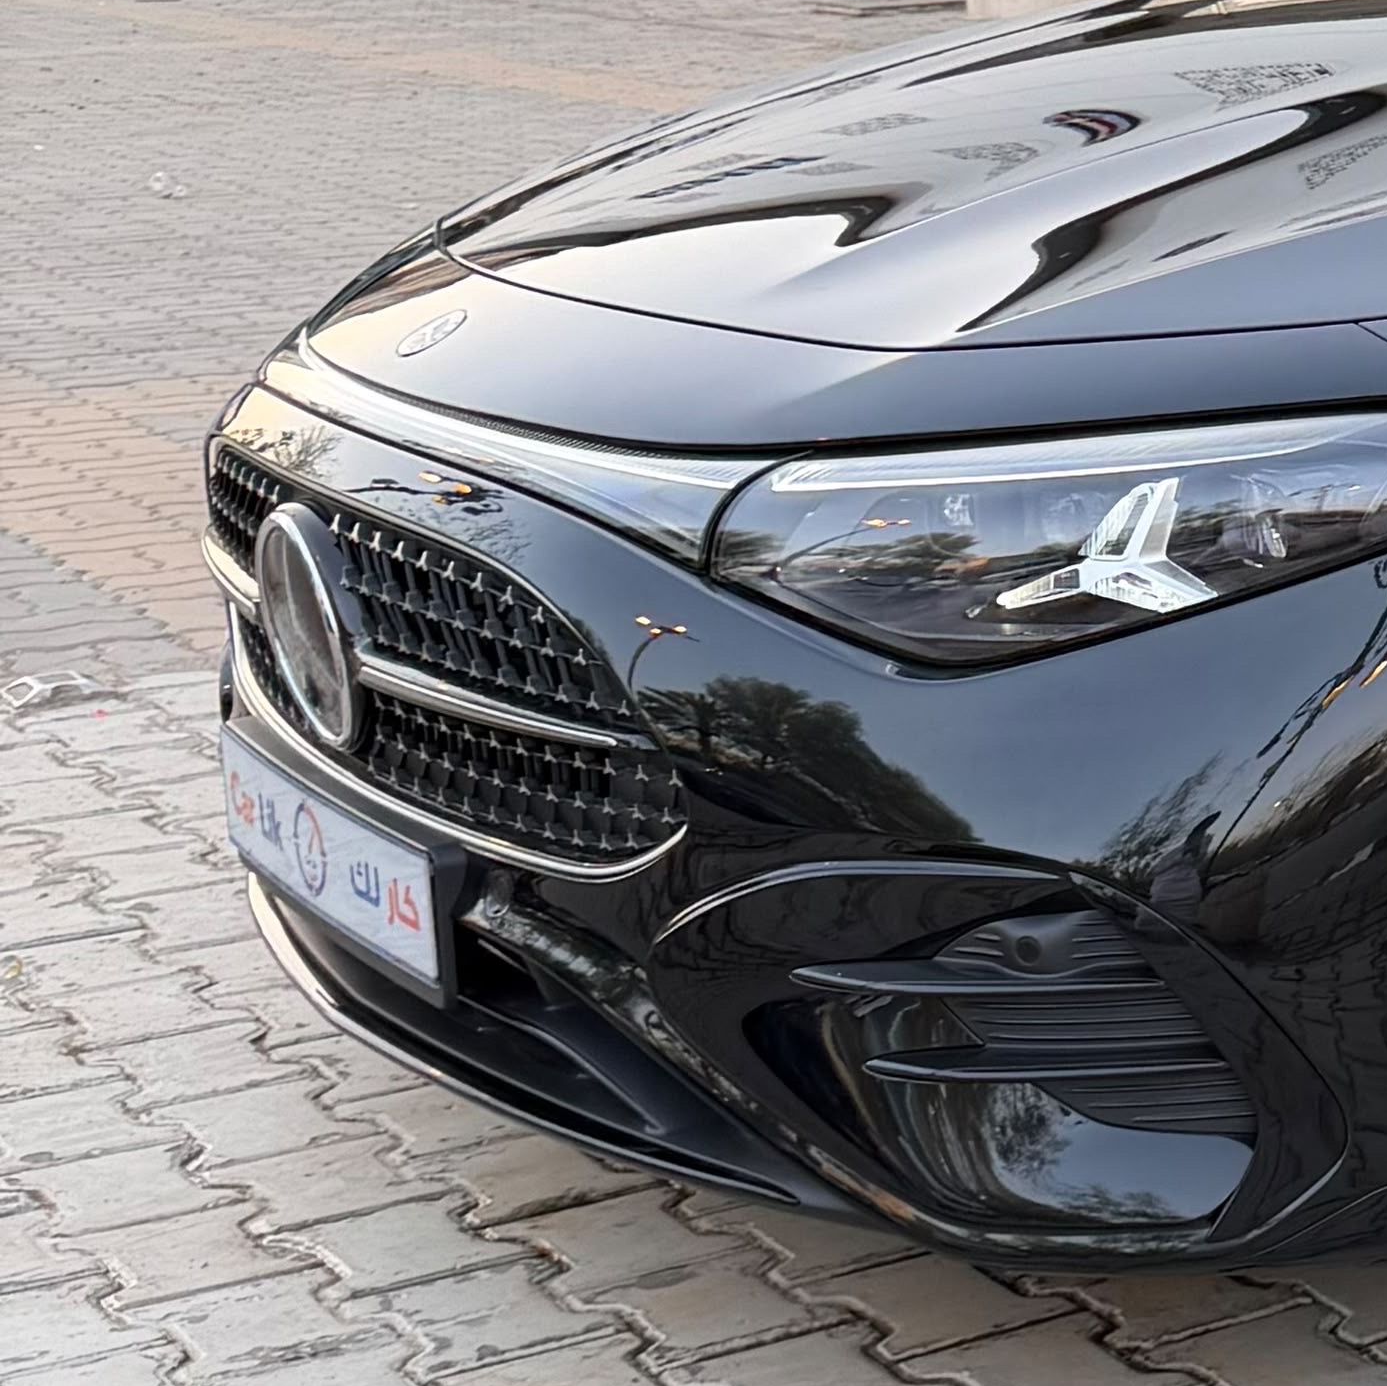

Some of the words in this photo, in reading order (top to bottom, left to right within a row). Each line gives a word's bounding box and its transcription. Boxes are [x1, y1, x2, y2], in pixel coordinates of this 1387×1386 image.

[231, 771, 255, 825] Car
[258, 792, 284, 851] Lik
[388, 877, 421, 931] كار
